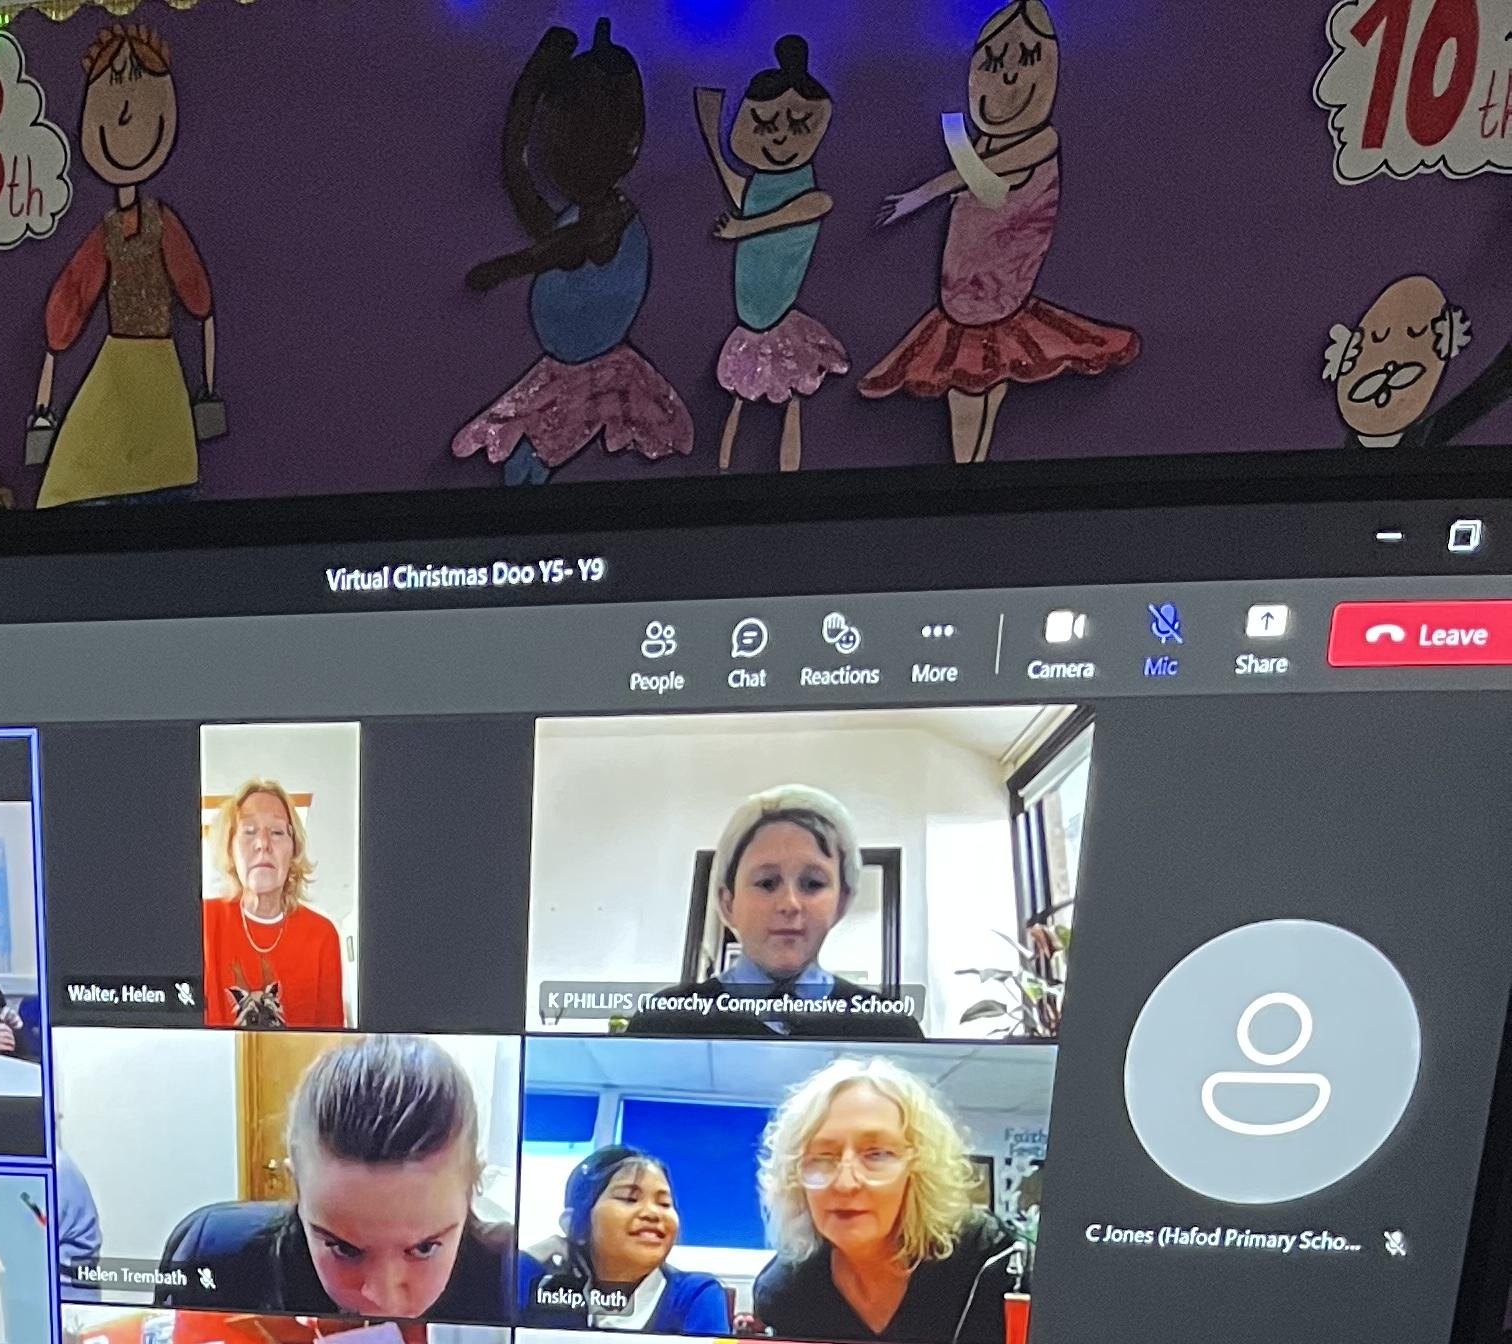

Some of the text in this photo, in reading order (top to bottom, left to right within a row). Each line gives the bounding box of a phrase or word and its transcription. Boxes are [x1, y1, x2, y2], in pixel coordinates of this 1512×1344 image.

[326, 566, 388, 591] Virtual
[393, 564, 488, 589] Christmas
[492, 561, 534, 585] Doo
[578, 557, 604, 581] Y9
[1418, 624, 1489, 647] Leave
[912, 664, 958, 683] More
[1028, 661, 1094, 679] Camera
[1143, 657, 1178, 677] Mic
[1235, 655, 1288, 674] Share
[630, 671, 685, 694] People
[728, 669, 767, 687] Chat
[800, 665, 880, 686] Reactions
[67, 984, 165, 1004] Walter, Helen
[548, 993, 915, 1017] K PHILLIPS (Treorchy Comprehensive School)
[1085, 1225, 1101, 1242] C
[1102, 1225, 1154, 1244] Jones
[1158, 1226, 1221, 1247] (Hafod
[1224, 1229, 1296, 1253] Primary
[78, 1266, 188, 1286] Helen Trembath
[537, 1287, 627, 1309] Inskip, Ruth
